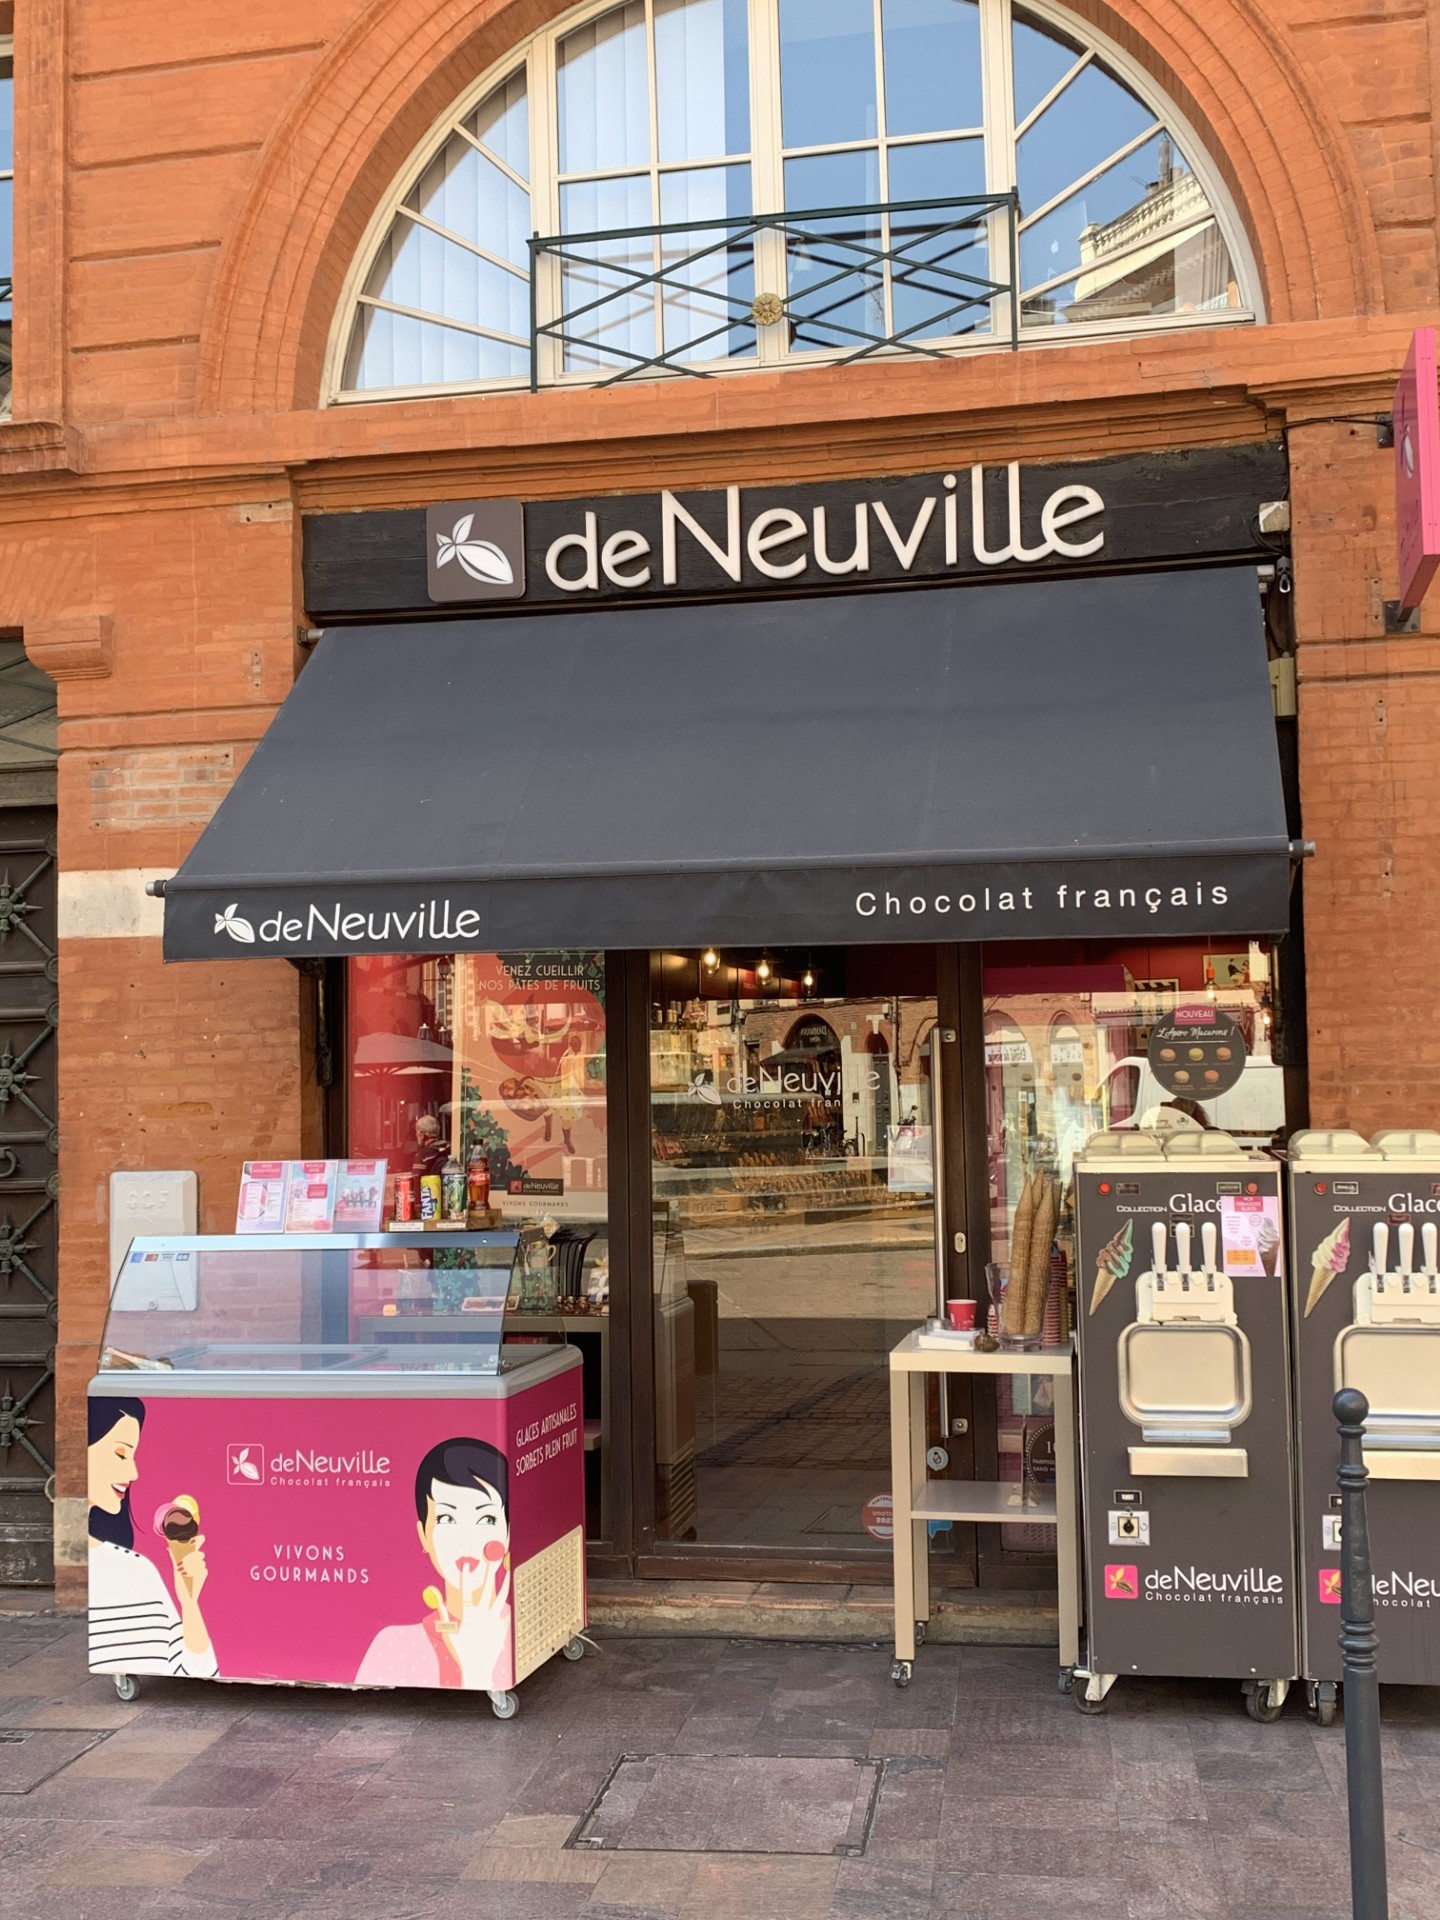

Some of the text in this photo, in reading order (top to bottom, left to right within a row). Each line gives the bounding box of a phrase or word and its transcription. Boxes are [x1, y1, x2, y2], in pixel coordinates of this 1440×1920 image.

[545, 460, 1105, 592] deNeuville
[854, 881, 1229, 916] Chocolat français
[259, 899, 480, 943] deNeuville
[495, 965, 585, 977] VENEZ CUEILLIR
[479, 978, 601, 991] NOS PÂTES DE FRUITS
[1175, 1009, 1214, 1019] NOUVEAU
[733, 1098, 803, 1109] Chocolat
[420, 1186, 435, 1221] FANTA
[529, 1200, 569, 1208] GOURMANDS
[515, 1402, 577, 1448] GLACES ARTISANALES
[270, 1449, 391, 1474] deNeuville
[515, 1427, 578, 1477] SORBETS PLEIN FRUIT
[270, 1476, 391, 1489] Chocolat français
[273, 1544, 345, 1561] VIVONS
[250, 1565, 369, 1584] GOURMANDS
[1144, 1565, 1283, 1593] deNeuville
[1145, 1591, 1284, 1605] Chocolat français
